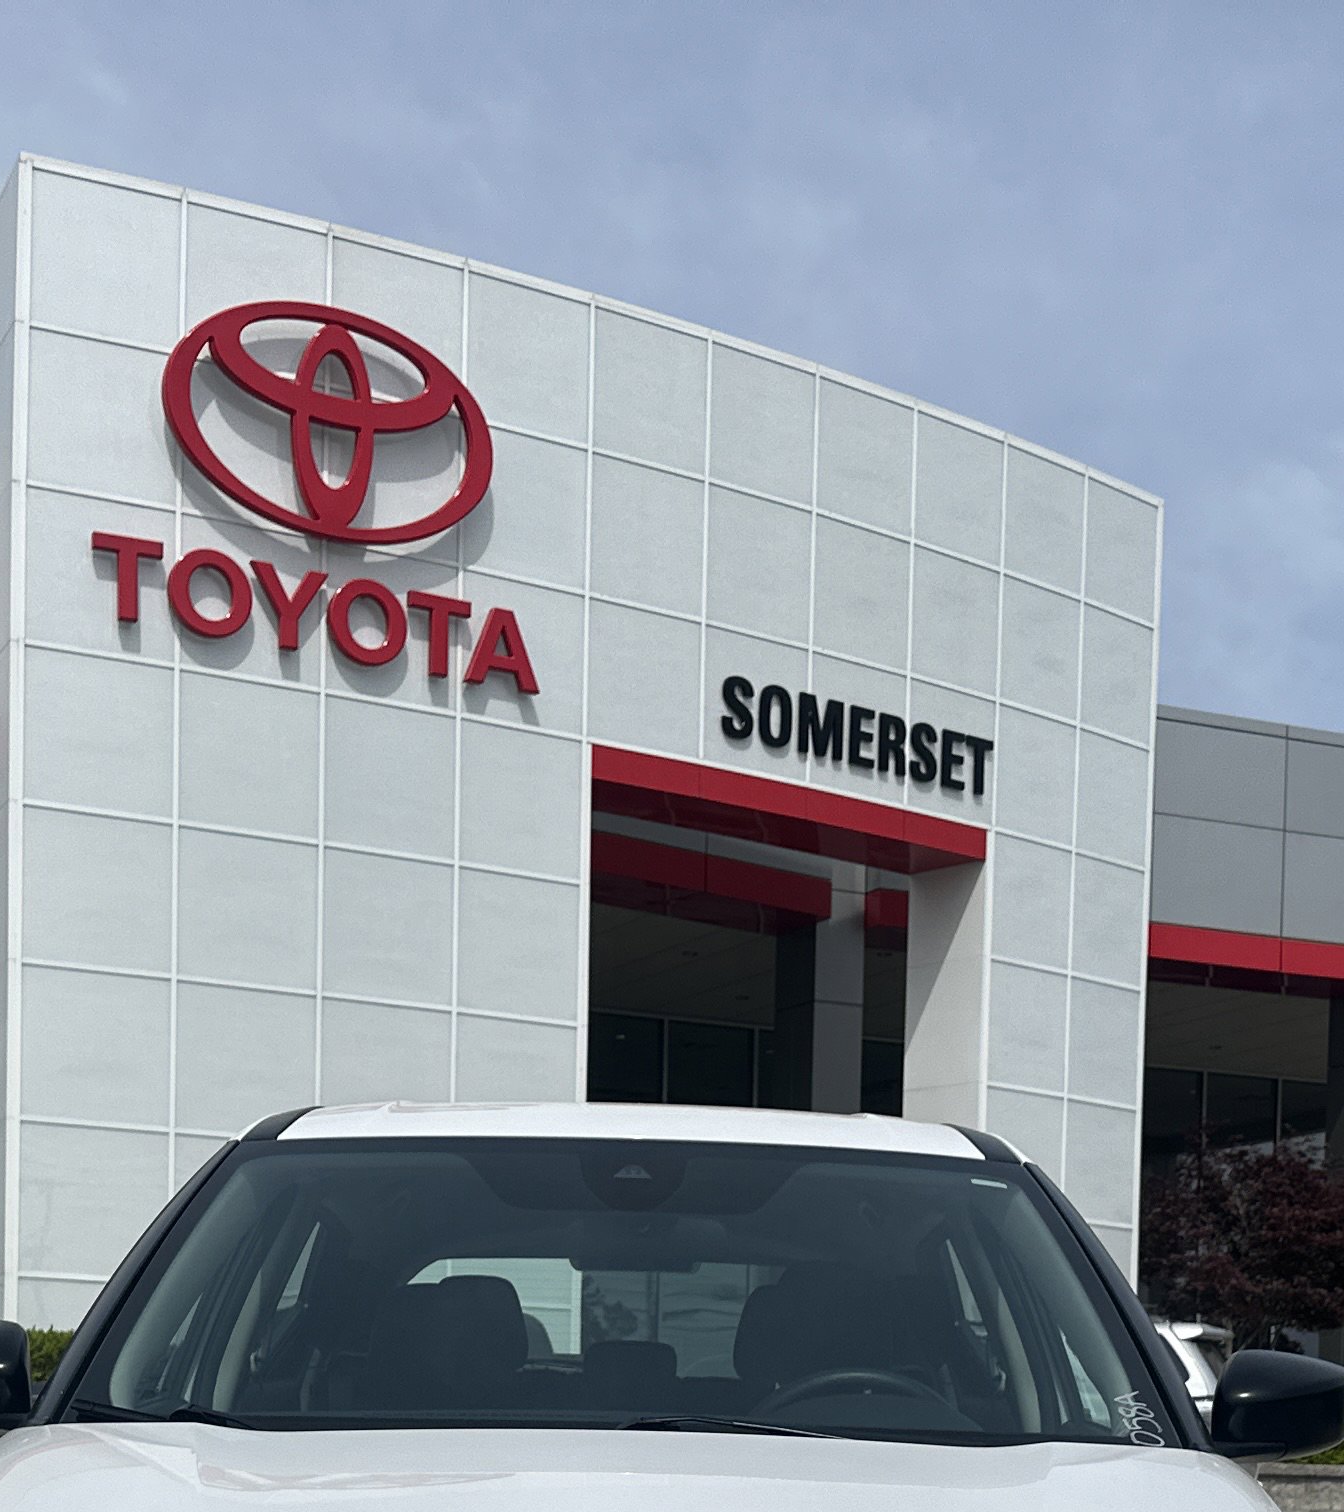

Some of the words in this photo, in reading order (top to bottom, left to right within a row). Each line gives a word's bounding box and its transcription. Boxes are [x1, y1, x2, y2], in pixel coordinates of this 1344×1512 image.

[91, 530, 540, 696] TOYOTA
[720, 675, 994, 797] SOMERSET
[1114, 1390, 1166, 1447] 058A
